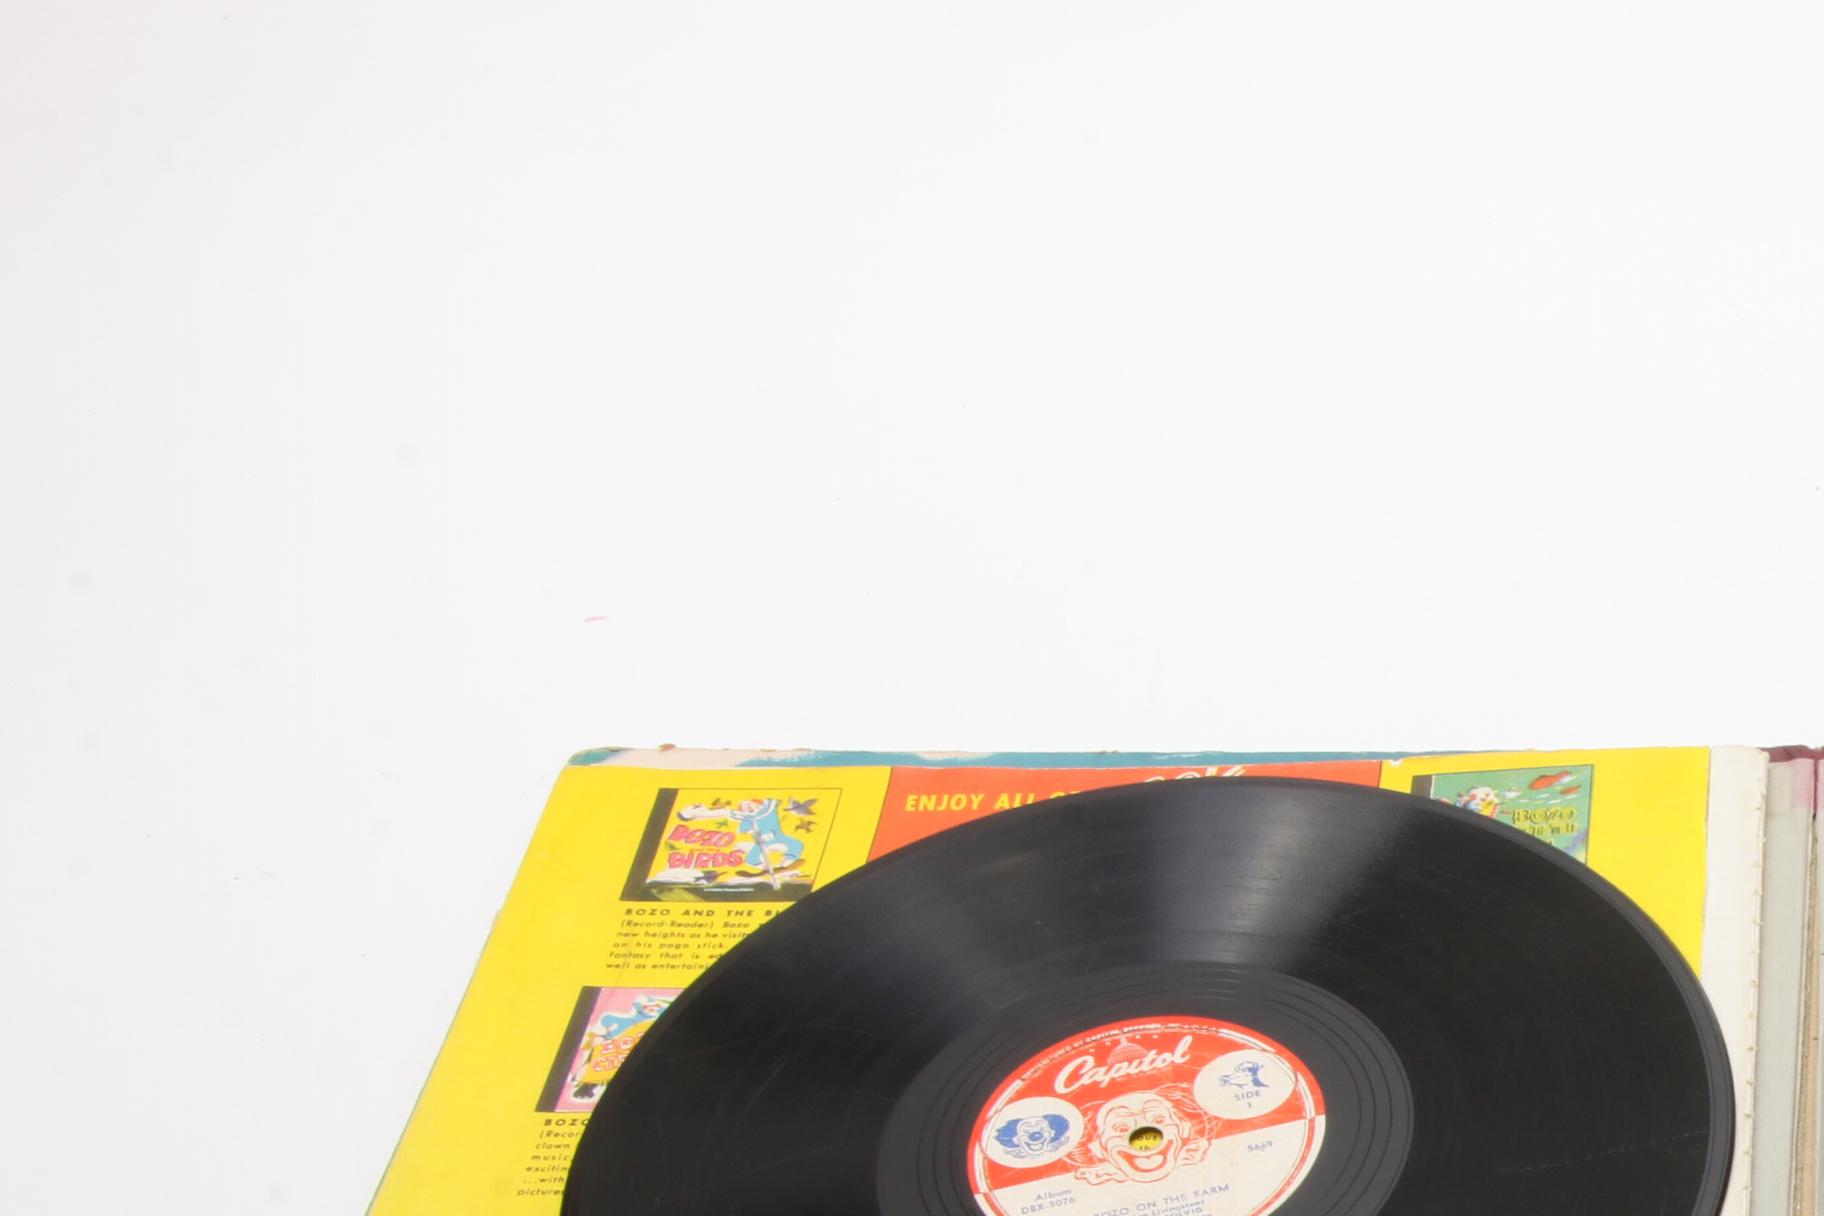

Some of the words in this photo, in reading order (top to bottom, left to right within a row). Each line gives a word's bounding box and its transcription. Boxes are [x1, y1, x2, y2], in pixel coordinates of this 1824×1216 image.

[905, 793, 984, 811] ENJOY
[667, 824, 736, 848] BOZO
[667, 849, 746, 869] BIRDS
[624, 908, 671, 917] BOZO
[681, 909, 715, 918] AND
[726, 909, 755, 918] THE
[620, 919, 715, 930] (Record-Reader)
[722, 920, 751, 930] Bozo
[644, 930, 687, 941] heights
[704, 930, 720, 940] he
[635, 941, 653, 949] his
[609, 951, 654, 962] fantasy
[660, 952, 685, 961] that
[690, 953, 701, 961] is
[606, 962, 632, 971] well
[634, 963, 648, 971] as
[1055, 1035, 1193, 1094] Capitol
[1232, 1089, 1262, 1102] SIDE
[535, 1141, 571, 1150] clown
[1034, 1189, 1073, 1202] Album
[1136, 1201, 1157, 1212] ON
[1163, 1193, 1188, 1205] THE
[1193, 1184, 1230, 1199] FARM
[1020, 1197, 1076, 1216] DBX-3076
